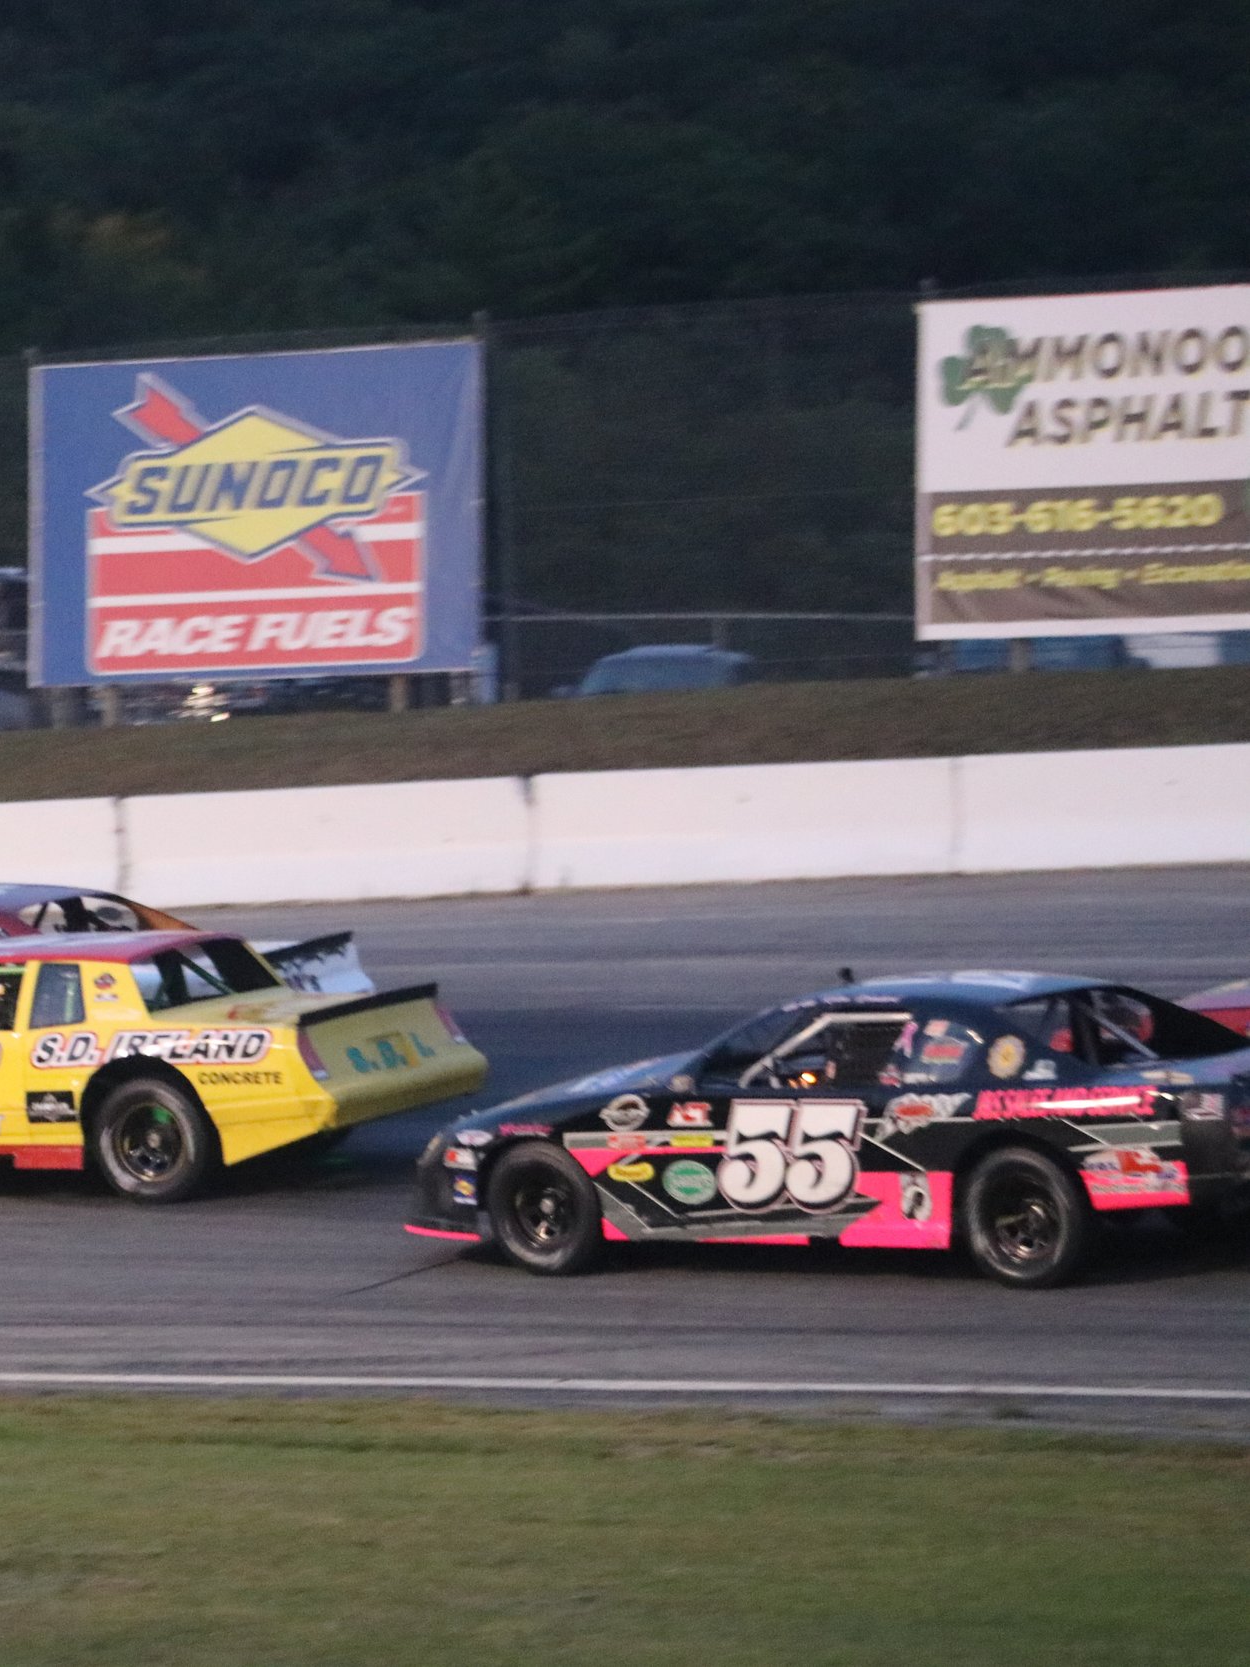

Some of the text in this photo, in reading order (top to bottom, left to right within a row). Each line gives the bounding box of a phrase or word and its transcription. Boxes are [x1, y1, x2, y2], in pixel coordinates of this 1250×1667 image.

[1006, 388, 1250, 448] ASPHALT
[124, 454, 390, 516] SUNOCO
[95, 606, 417, 659] RACE FUELS
[105, 1028, 274, 1066] IRELAND
[199, 1071, 284, 1086] CONCRETE
[717, 1098, 868, 1214] 55
